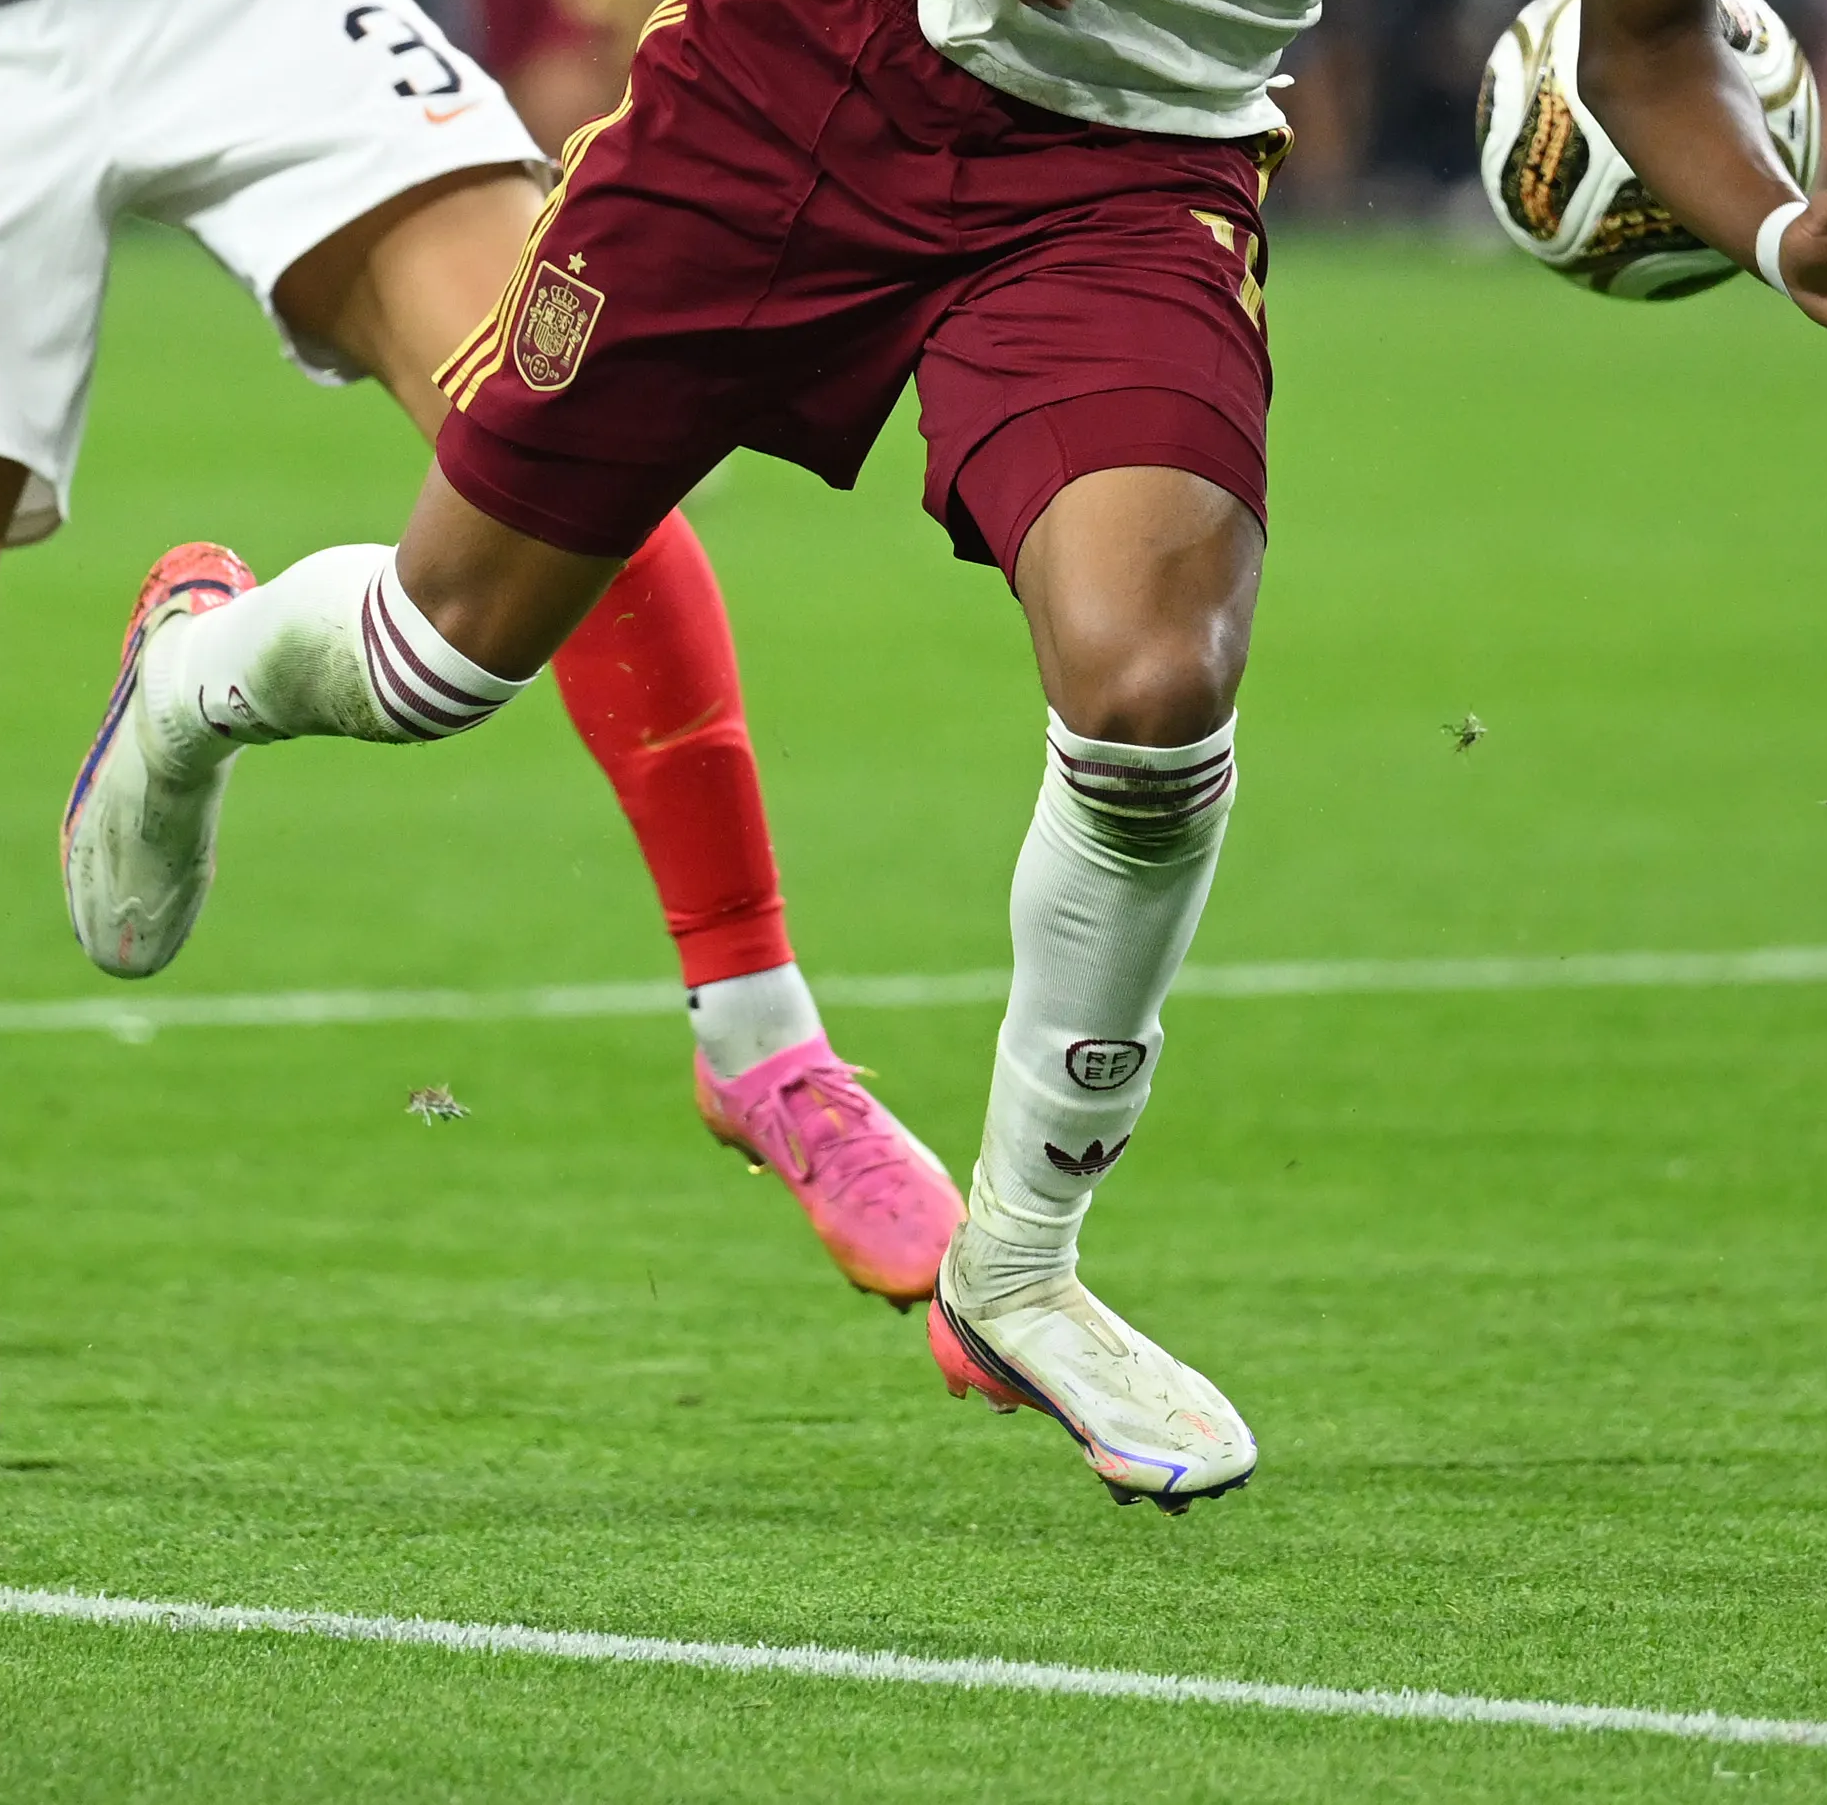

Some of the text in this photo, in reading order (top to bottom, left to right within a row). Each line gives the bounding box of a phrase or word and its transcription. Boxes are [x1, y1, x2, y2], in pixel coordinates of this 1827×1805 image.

[345, 3, 466, 99] 3
[1085, 1050, 1132, 1066] RF
[1085, 1064, 1127, 1080] EF
